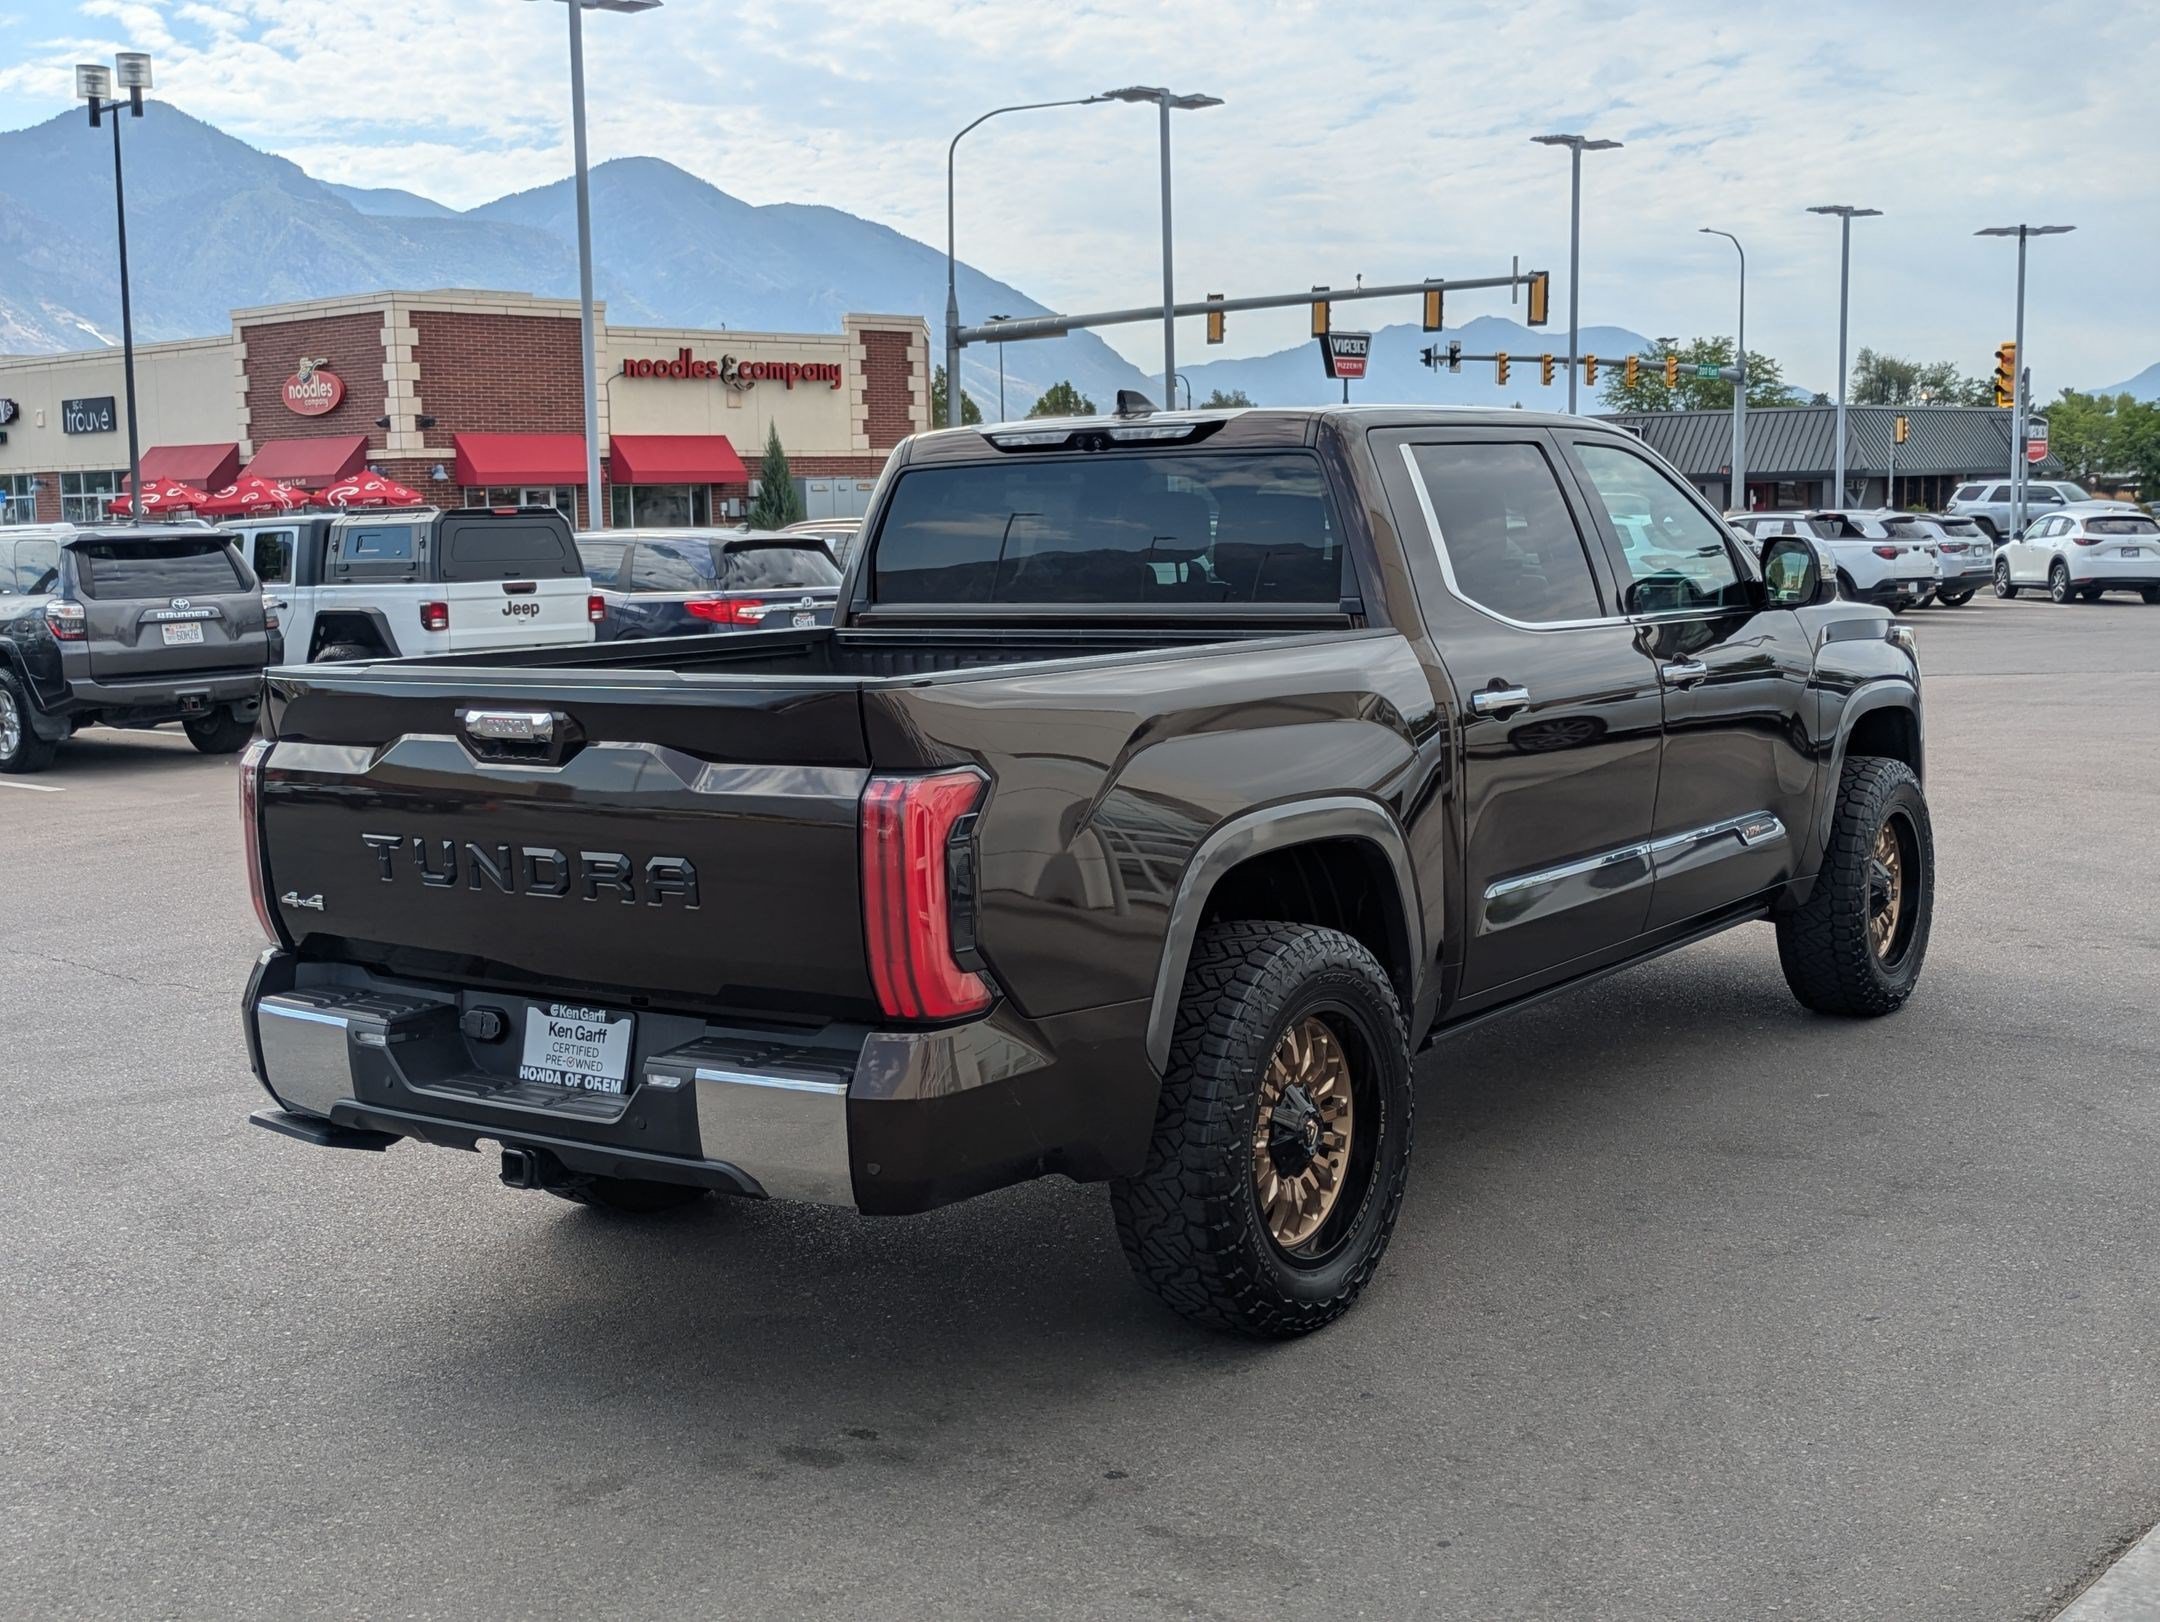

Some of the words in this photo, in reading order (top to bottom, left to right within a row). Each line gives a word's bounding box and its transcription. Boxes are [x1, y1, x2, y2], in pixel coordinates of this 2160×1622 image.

[623, 347, 718, 379] noodles
[738, 361, 842, 390] company
[288, 374, 333, 399] noodles
[502, 601, 540, 617] Jeep
[361, 833, 701, 910] TUNDRA
[559, 1004, 580, 1019] Ken
[580, 1007, 606, 1022] Garff
[548, 1021, 573, 1039] Ken
[575, 1025, 607, 1044] Garff
[552, 1041, 600, 1059] CERTIFIED
[519, 1065, 562, 1085] HONDA
[565, 1072, 582, 1087] OF
[584, 1077, 621, 1094] OREM
